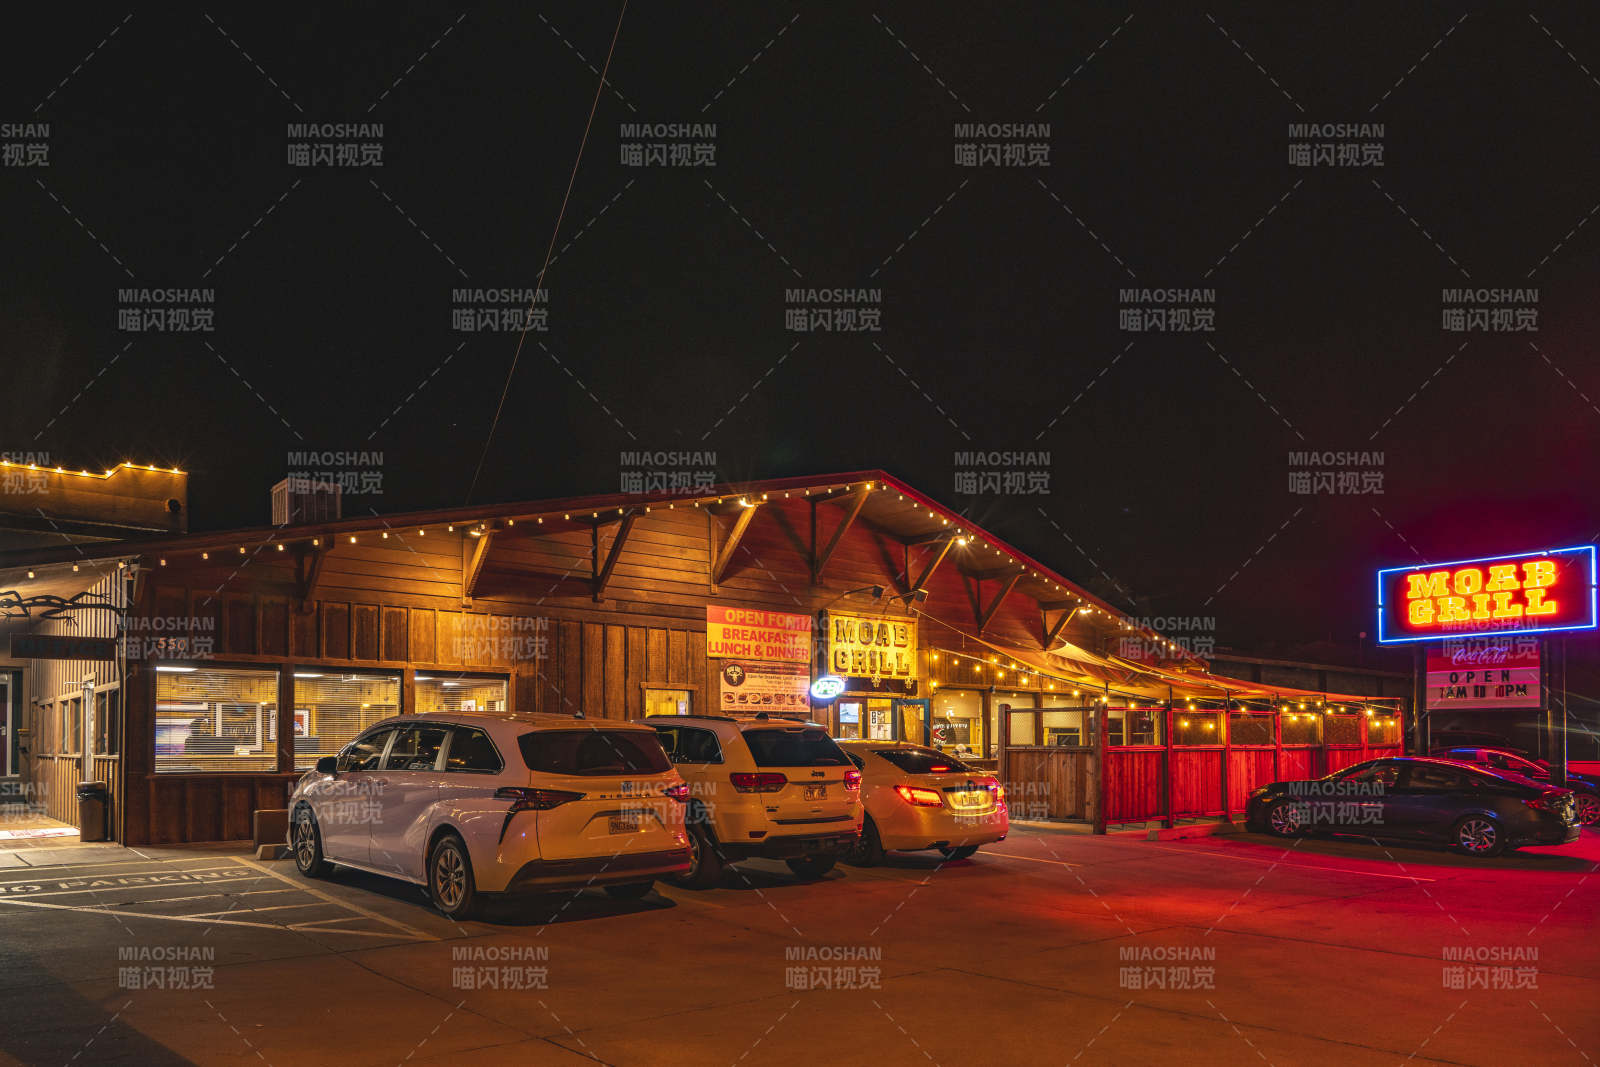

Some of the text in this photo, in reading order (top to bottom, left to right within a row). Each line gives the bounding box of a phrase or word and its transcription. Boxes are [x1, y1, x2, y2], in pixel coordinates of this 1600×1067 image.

[1407, 561, 1556, 599] MOAB
[1408, 588, 1557, 625] GRILL
[725, 609, 765, 626] OPEN
[722, 627, 798, 646] BREAKFAST
[835, 619, 908, 648] MOAB
[157, 637, 187, 651] 550
[708, 641, 751, 656] LUNCH
[754, 644, 762, 657] &
[765, 646, 809, 660] DINNER
[834, 648, 910, 676] GRILL
[1449, 670, 1510, 684] OPEN
[58, 869, 250, 889] PARKING
